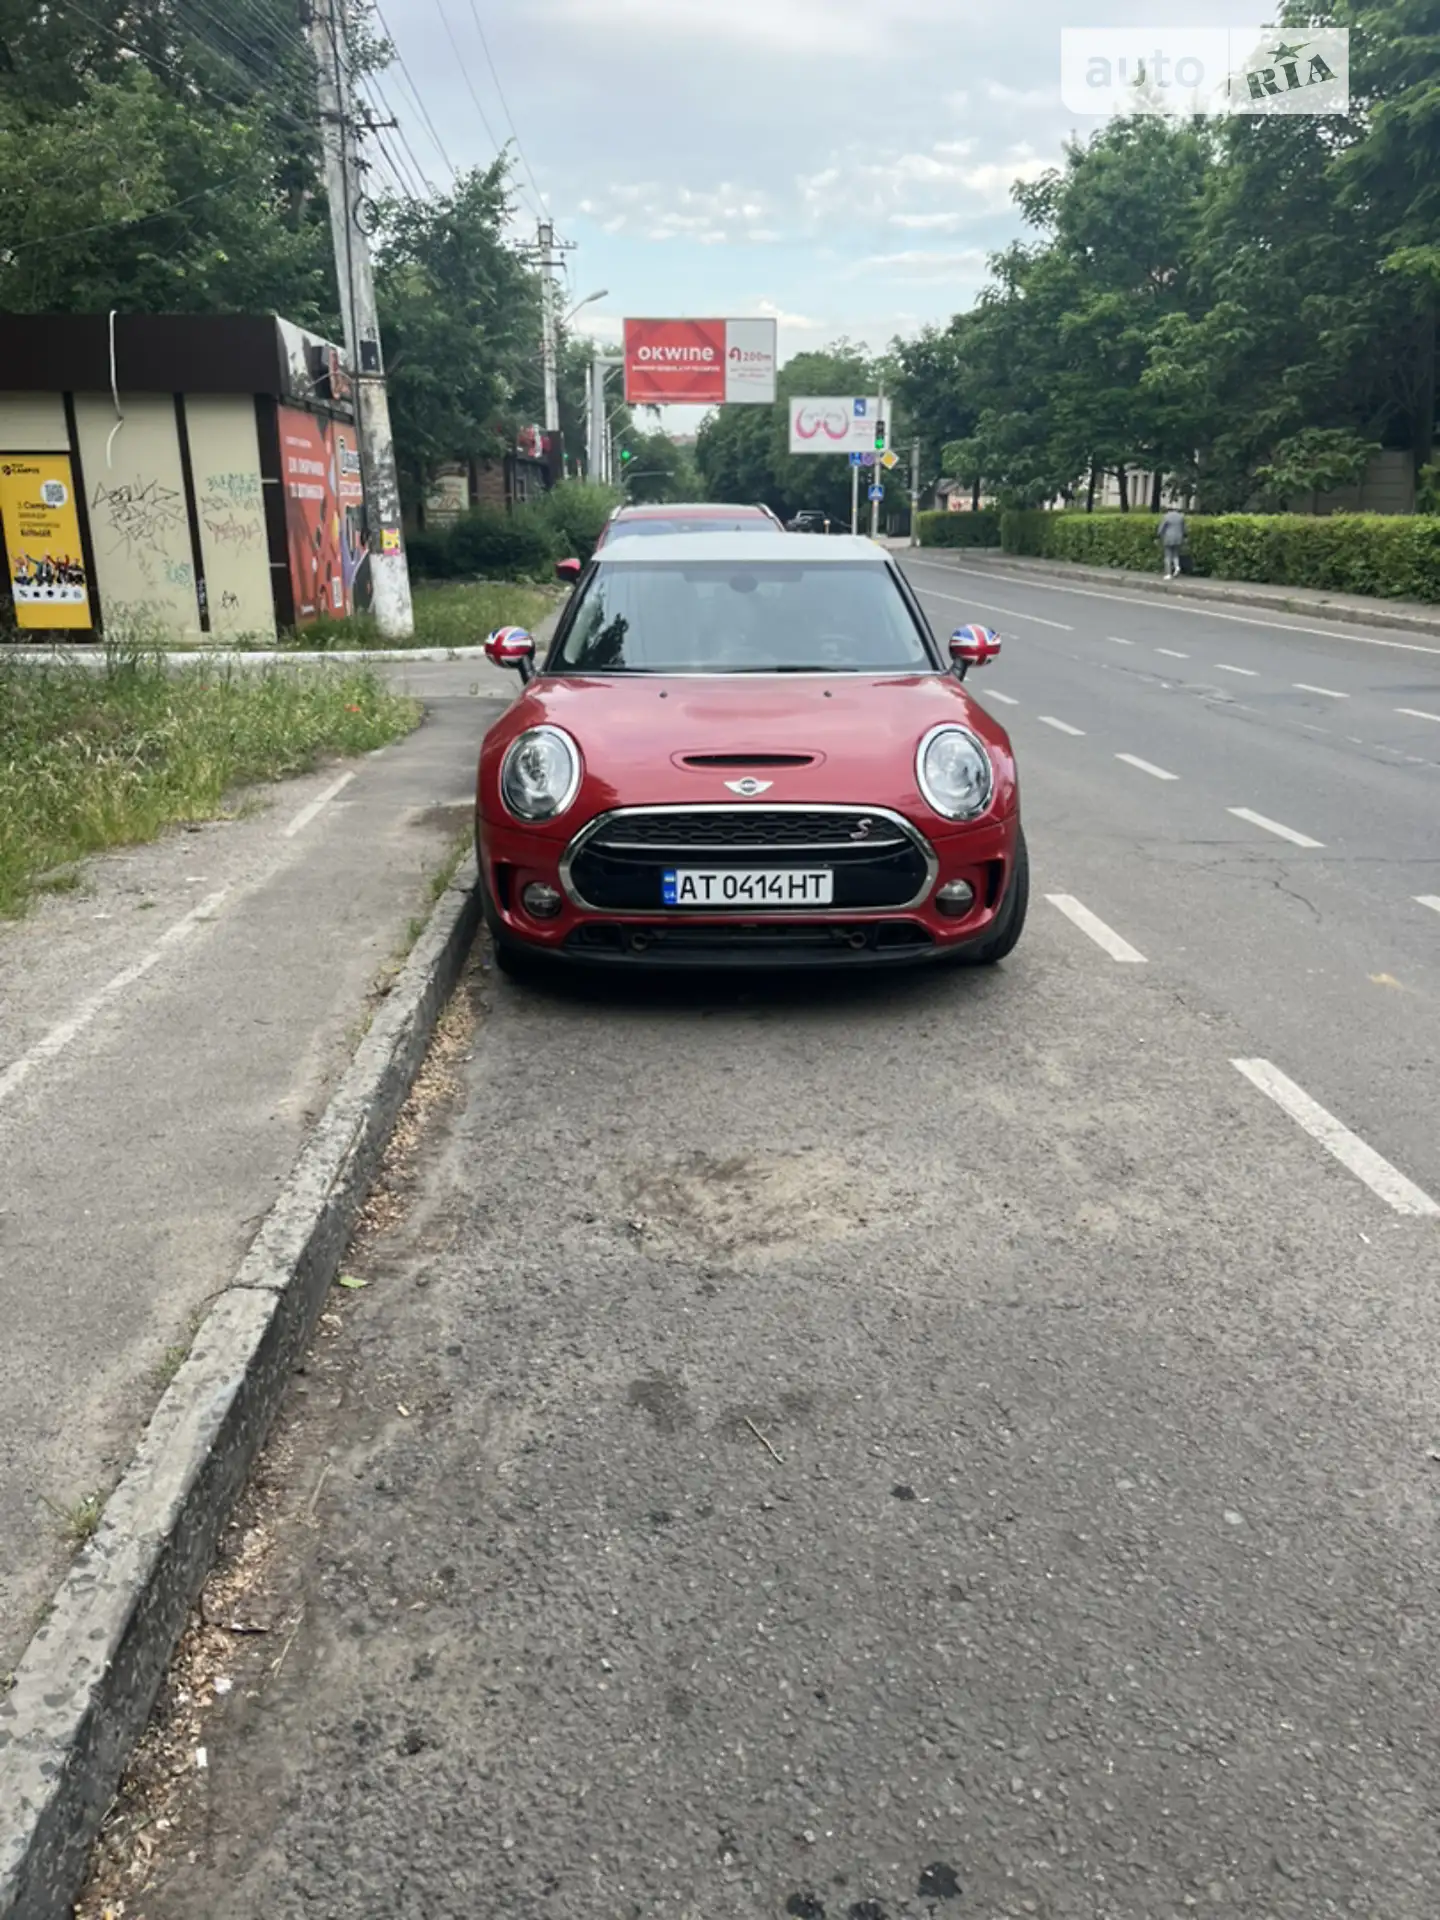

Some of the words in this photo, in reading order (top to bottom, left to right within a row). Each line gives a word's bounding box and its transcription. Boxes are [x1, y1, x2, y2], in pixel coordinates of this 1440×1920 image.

[850, 818, 873, 840] S
[680, 875, 717, 900] AT
[723, 874, 783, 900] 0414
[788, 874, 827, 899] HT
